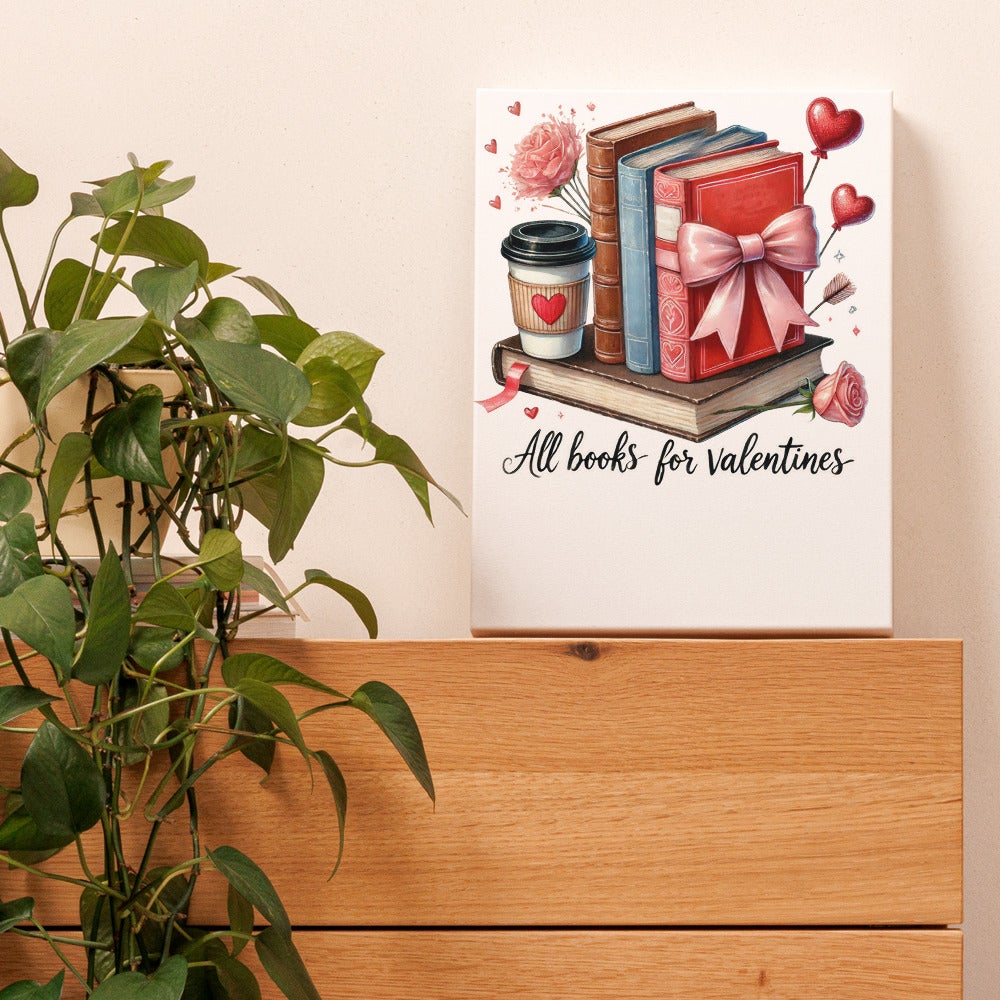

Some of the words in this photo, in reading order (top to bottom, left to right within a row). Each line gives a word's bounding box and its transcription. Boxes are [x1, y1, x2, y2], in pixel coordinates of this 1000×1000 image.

[502, 429, 562, 478] All
[567, 430, 649, 472] books
[654, 439, 699, 486] for
